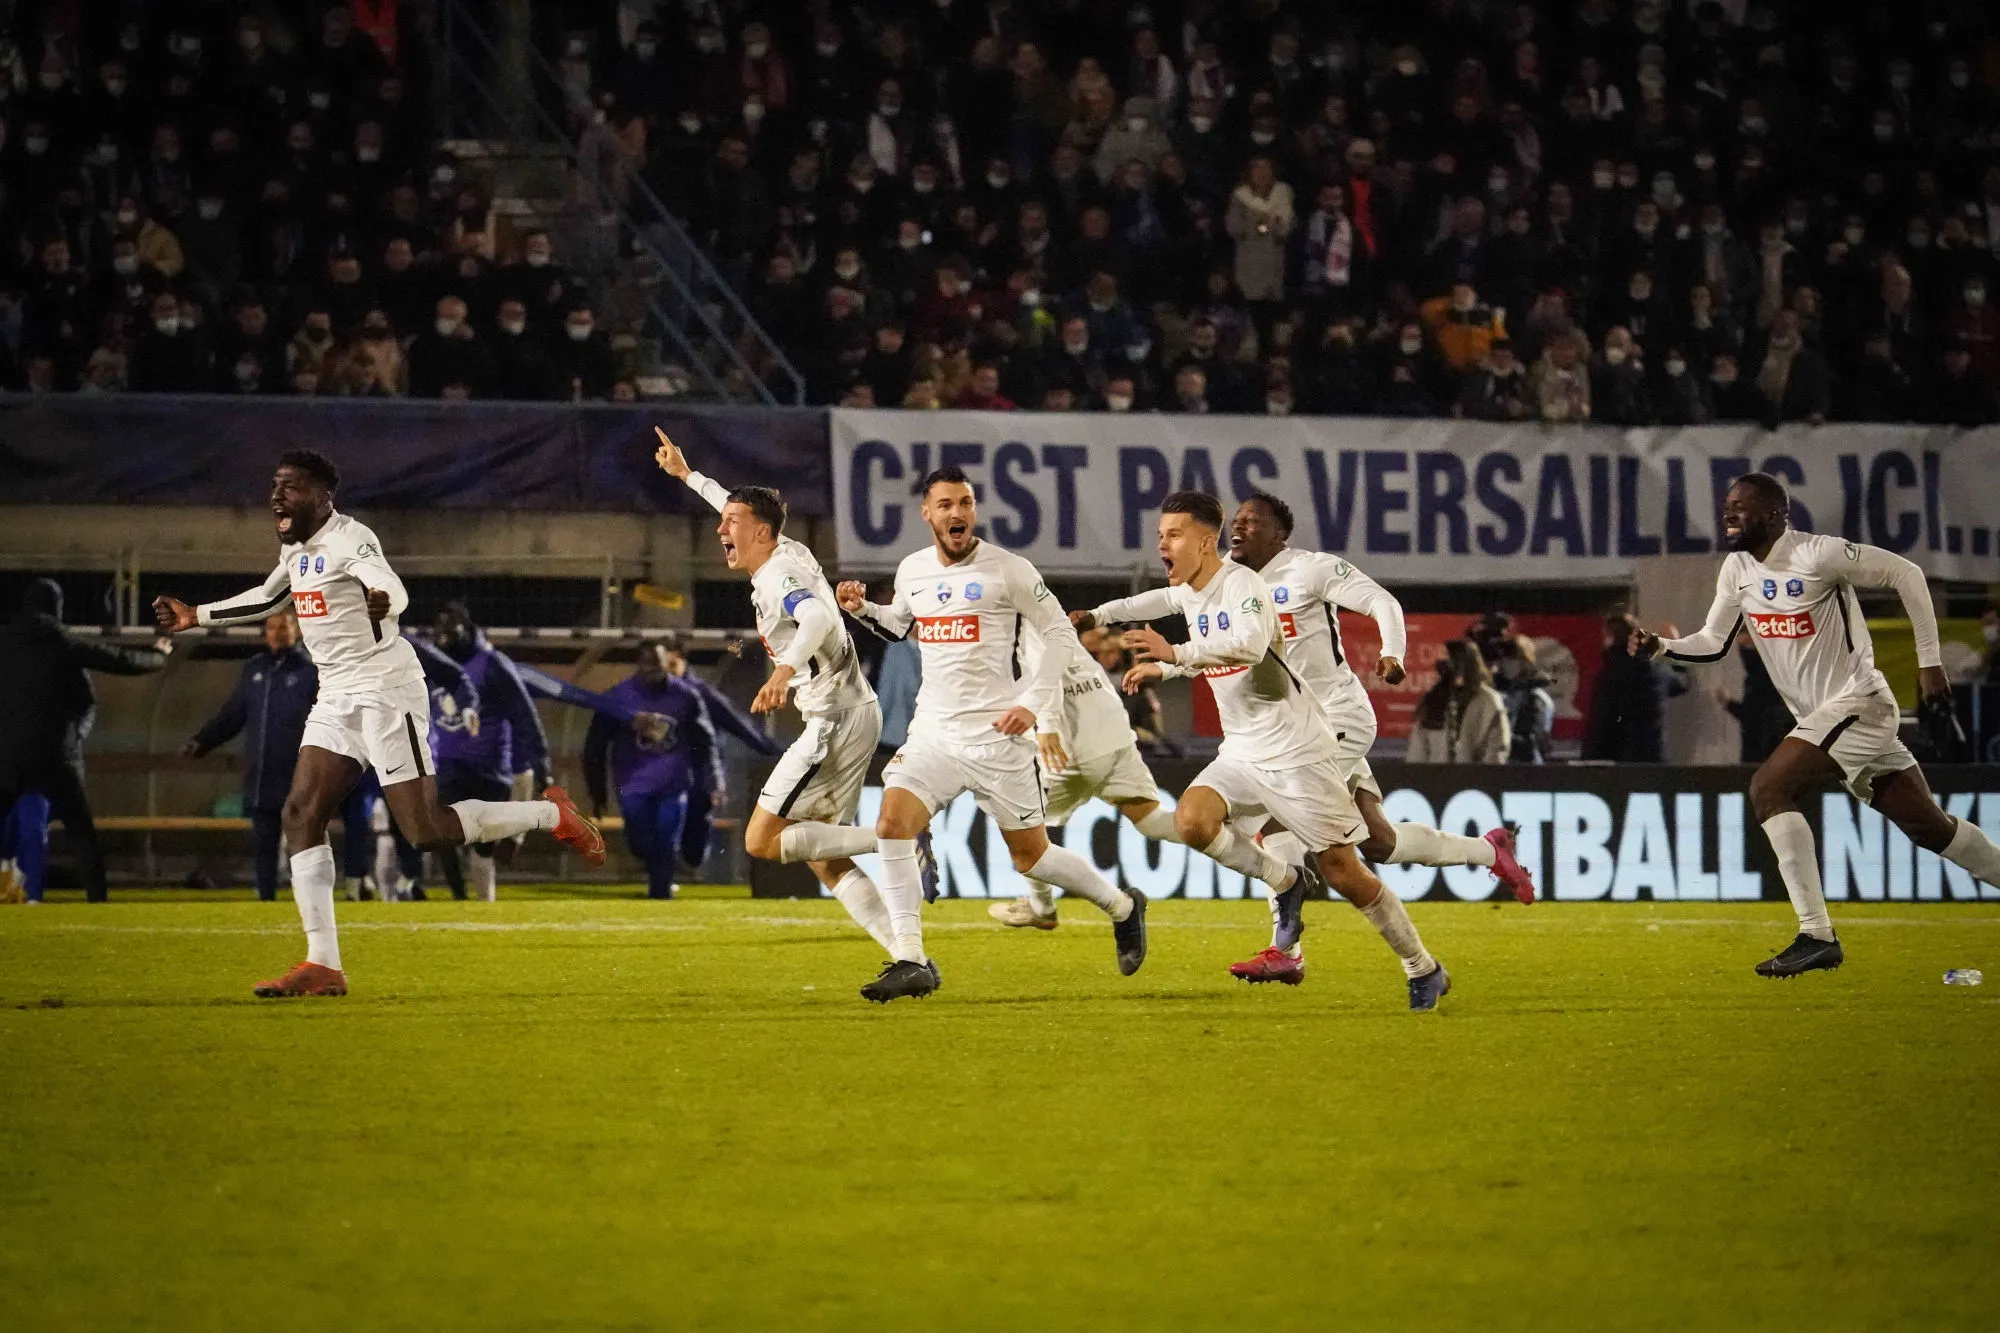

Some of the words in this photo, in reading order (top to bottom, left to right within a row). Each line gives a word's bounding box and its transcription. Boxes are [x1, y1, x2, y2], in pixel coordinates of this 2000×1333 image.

[1305, 450, 1813, 556] VERSAILLES
[1836, 449, 2000, 556] ICI..
[294, 594, 323, 615] tclic
[1326, 788, 1762, 901] OOTBALL
